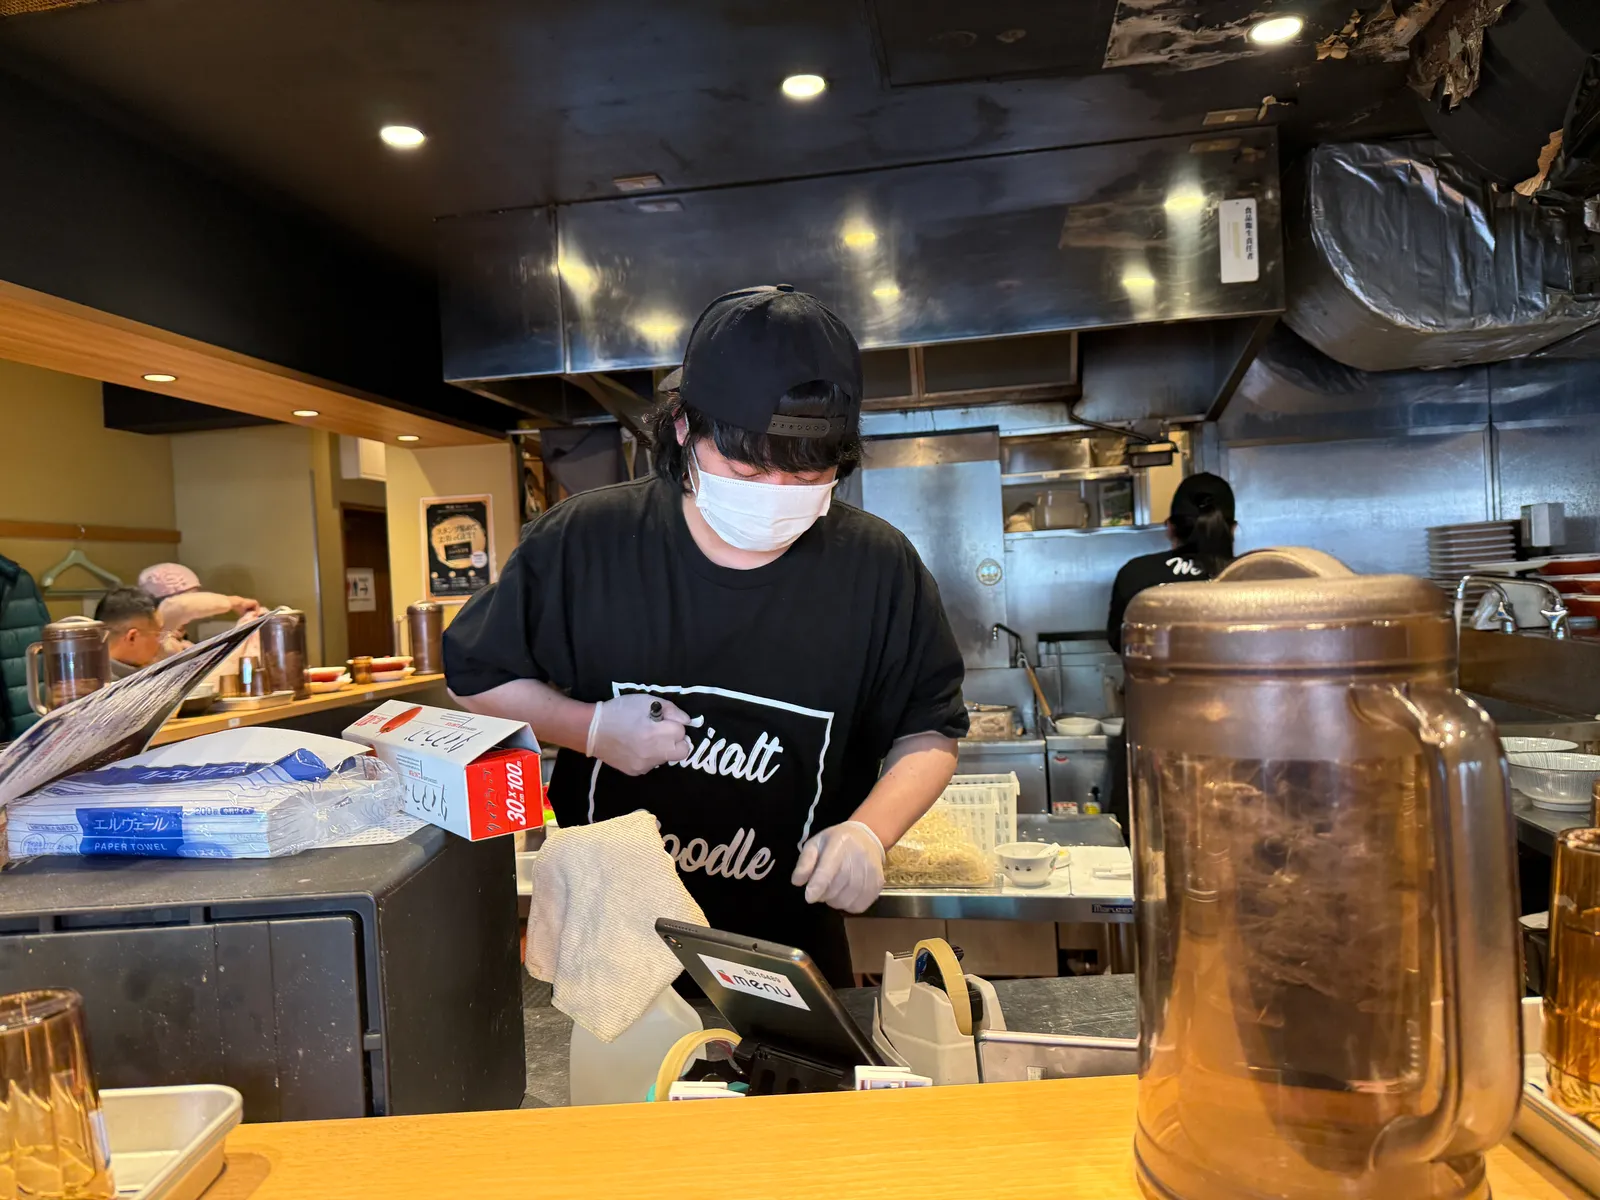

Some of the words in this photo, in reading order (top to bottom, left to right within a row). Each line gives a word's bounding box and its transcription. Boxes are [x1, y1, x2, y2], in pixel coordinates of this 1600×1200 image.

[93, 816, 170, 833] エルヴェール
[94, 842, 128, 852] PAPER
[130, 843, 168, 852] TOWEL
[657, 826, 776, 881] oodle
[732, 974, 791, 998] menu
